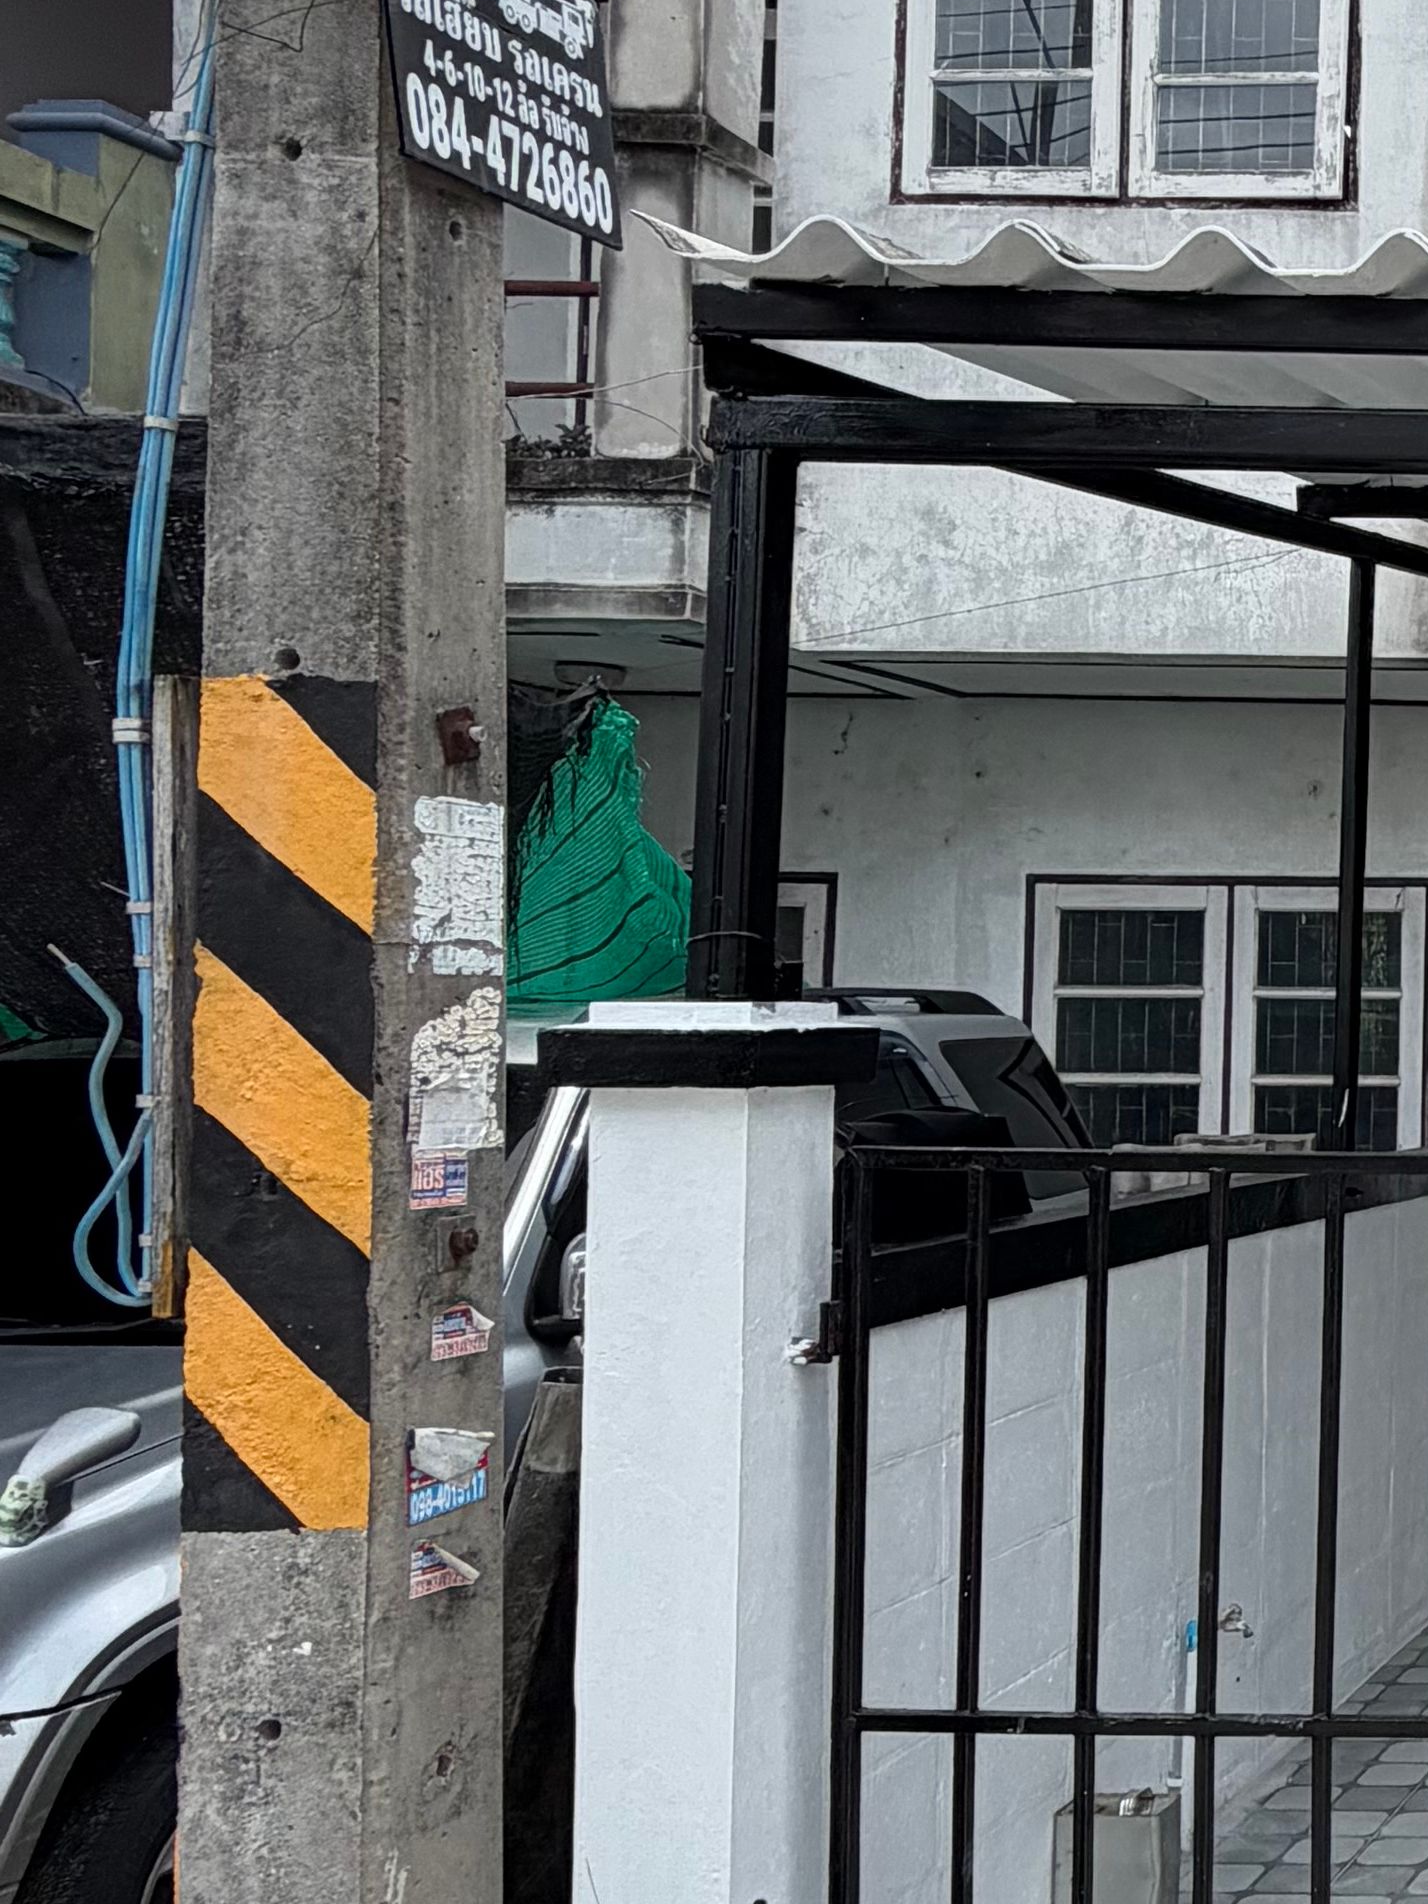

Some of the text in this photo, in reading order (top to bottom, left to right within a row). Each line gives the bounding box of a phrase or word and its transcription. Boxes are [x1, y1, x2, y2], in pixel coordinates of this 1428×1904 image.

[424, 39, 516, 118] 4-6-10-12
[508, 39, 603, 118] รถเครน
[406, 72, 613, 235] 084-4726860
